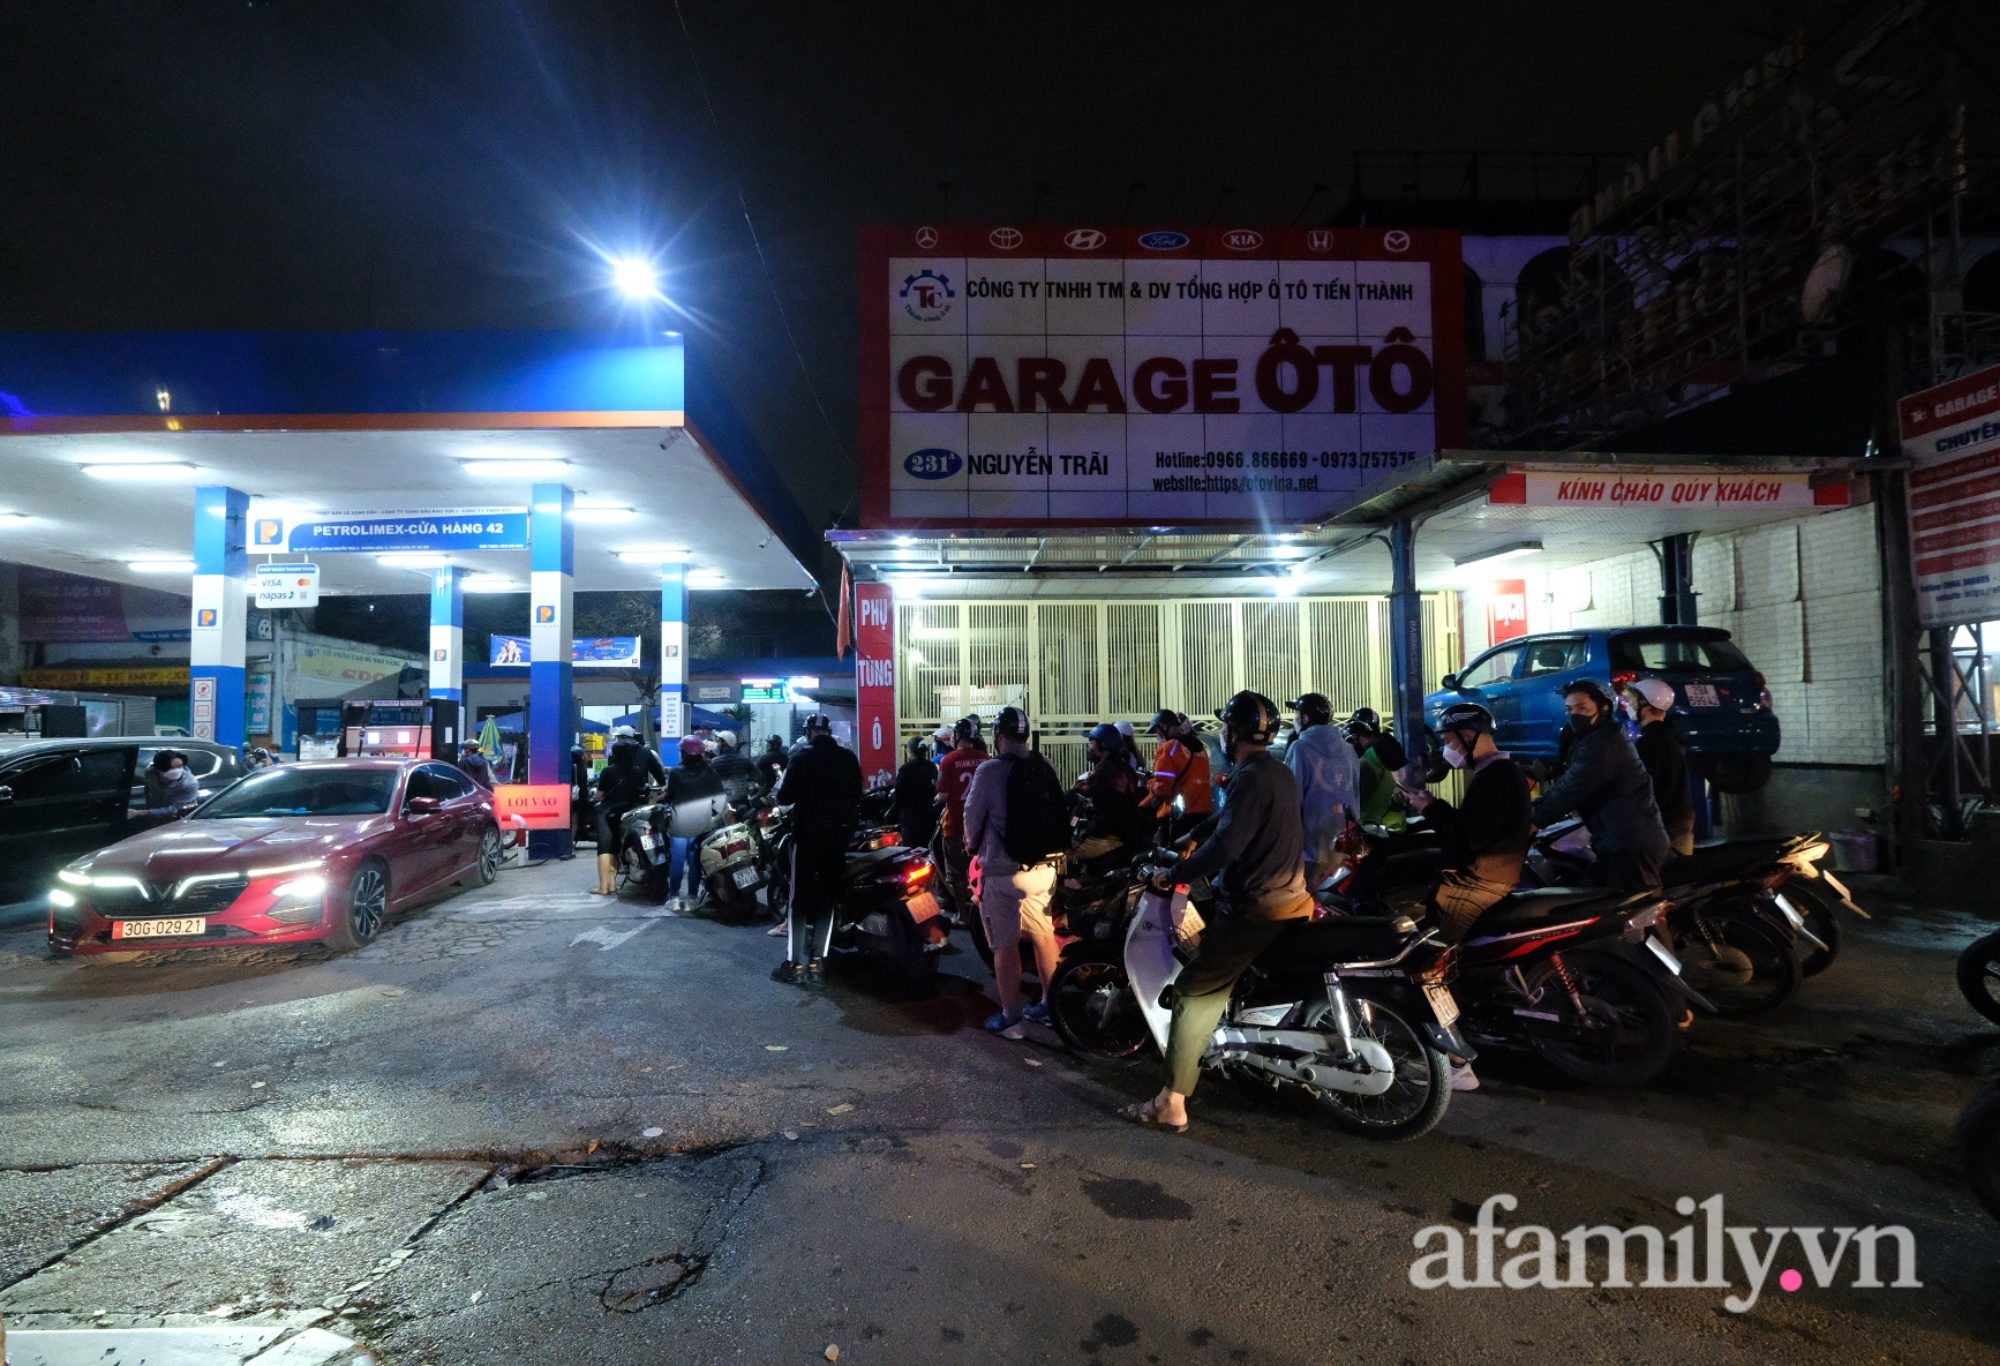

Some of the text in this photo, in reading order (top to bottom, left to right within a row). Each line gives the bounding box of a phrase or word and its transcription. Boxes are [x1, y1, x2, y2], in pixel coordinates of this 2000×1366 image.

[1230, 234, 1256, 246] KIA
[966, 275, 1413, 304] CÔNG TY TNHH TM & DV TỔNG HỢP Ô TÔ TIẾN THÀNH
[898, 355, 1240, 414] GARAGE
[1933, 385, 1999, 420] GARAGE
[968, 447, 1053, 475] NGUYỄN
[1059, 451, 1109, 475] TRÃI
[1557, 477, 1783, 504] KÍNH CHÀO QÚY KHÁCH
[442, 520, 483, 534] HÀNG
[486, 522, 504, 534] 42
[261, 578, 282, 587] VISA
[258, 592, 288, 602] napas
[861, 599, 888, 631] PHỤ
[858, 655, 893, 688] TÙNG
[872, 716, 883, 750] Ô
[125, 919, 201, 937] 30G-029.21
